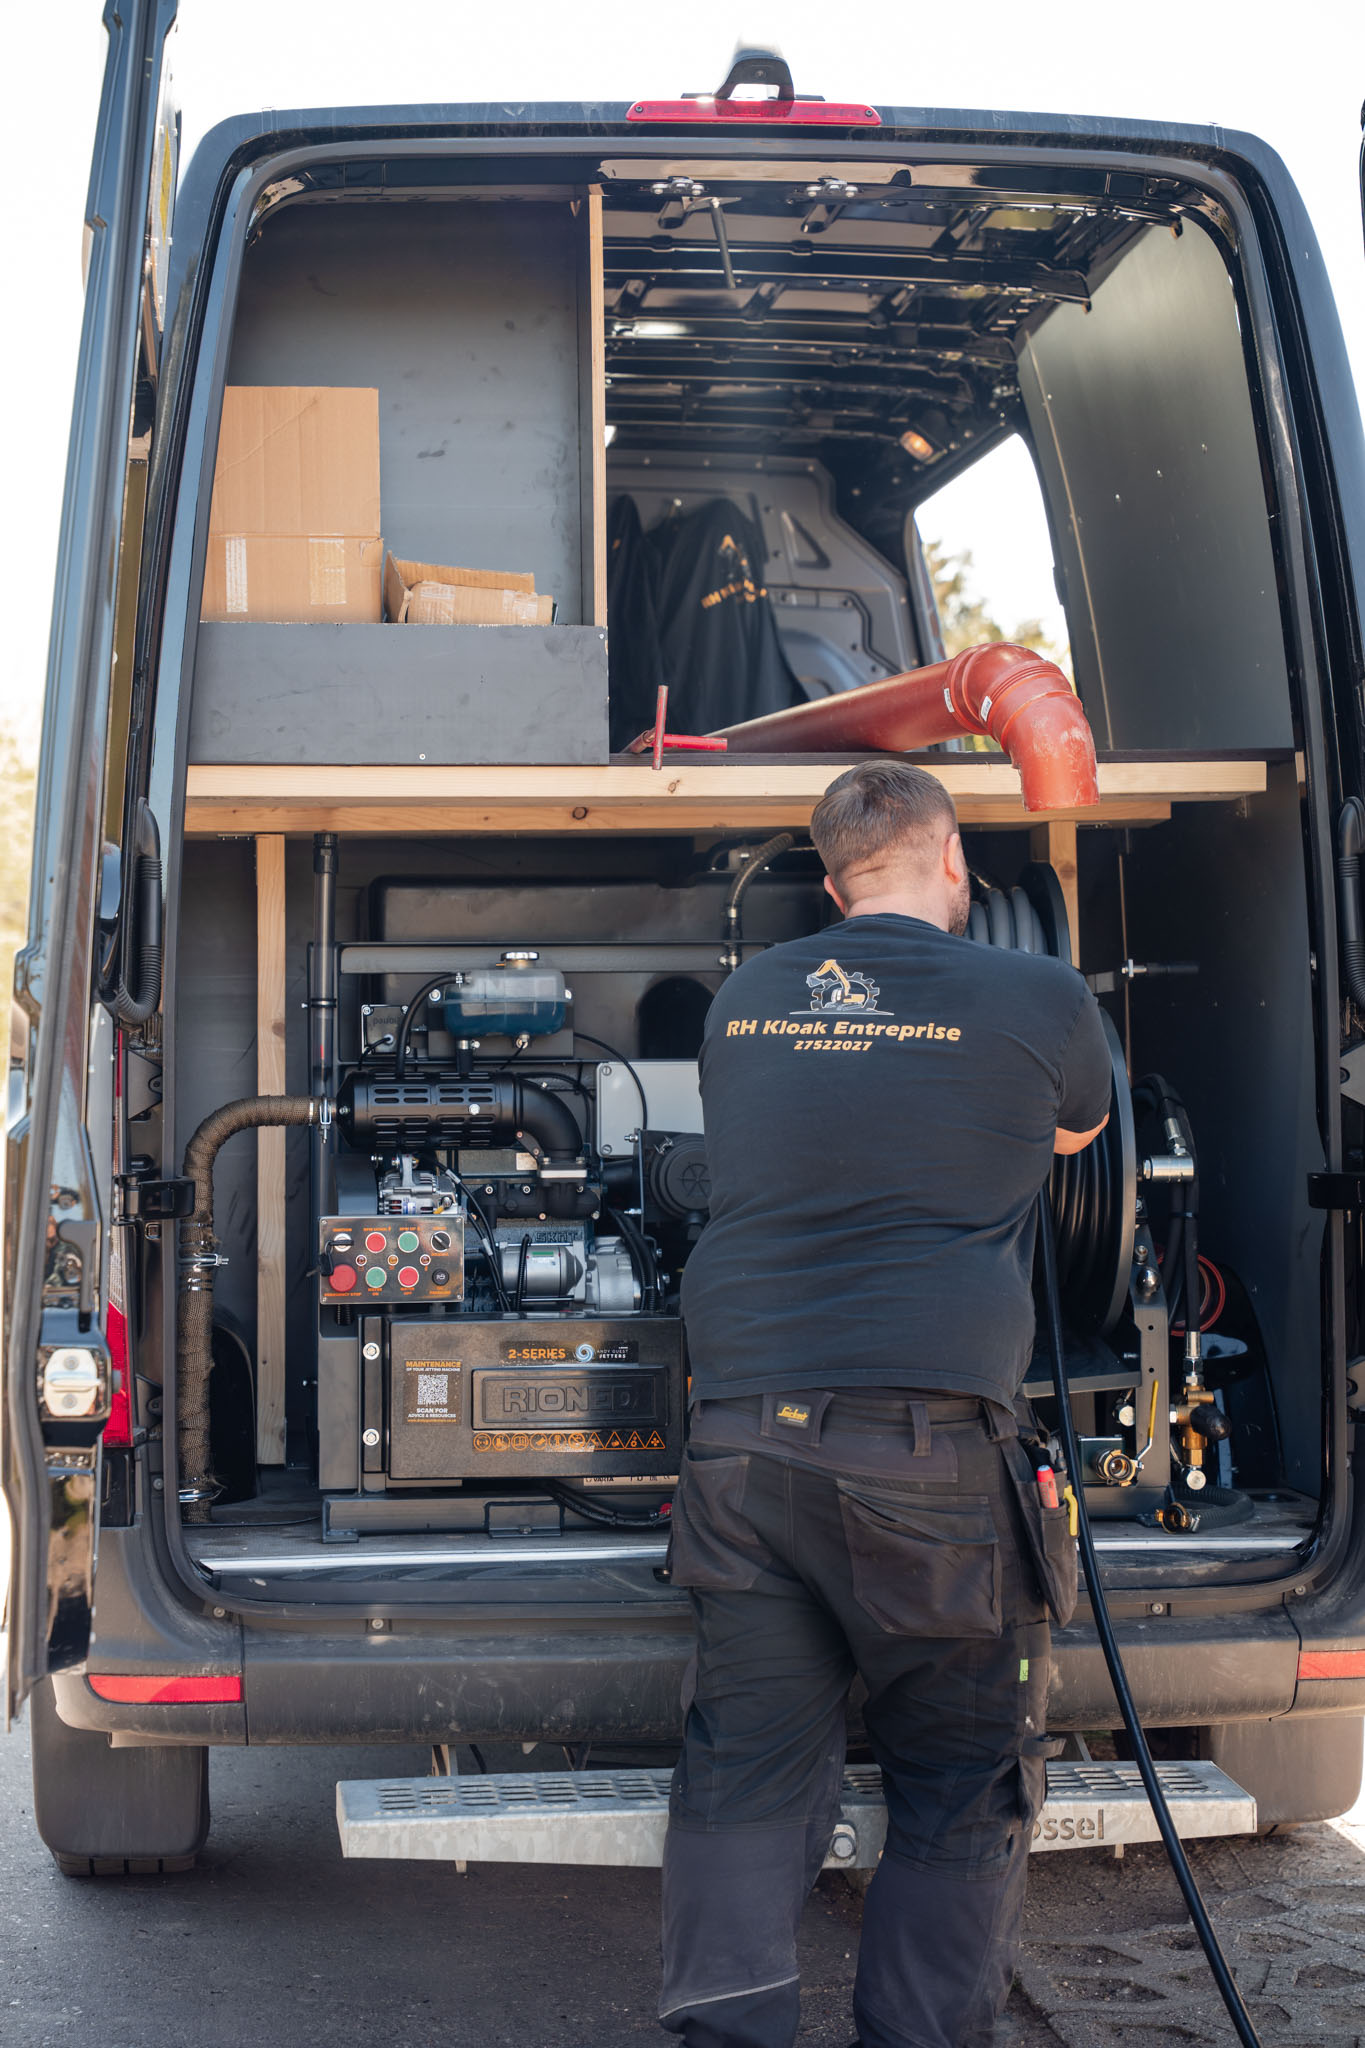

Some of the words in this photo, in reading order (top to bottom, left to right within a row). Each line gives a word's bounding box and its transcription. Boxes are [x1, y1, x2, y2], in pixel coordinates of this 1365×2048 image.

[726, 1020, 757, 1037] RH
[762, 1020, 828, 1035] Kloak
[833, 1021, 962, 1042] Entreprise
[793, 1040, 873, 1051] 27522027
[508, 1348, 566, 1360] 2-SERIES
[405, 1360, 462, 1368] MAINTENANCE
[503, 1386, 638, 1412] RIONED
